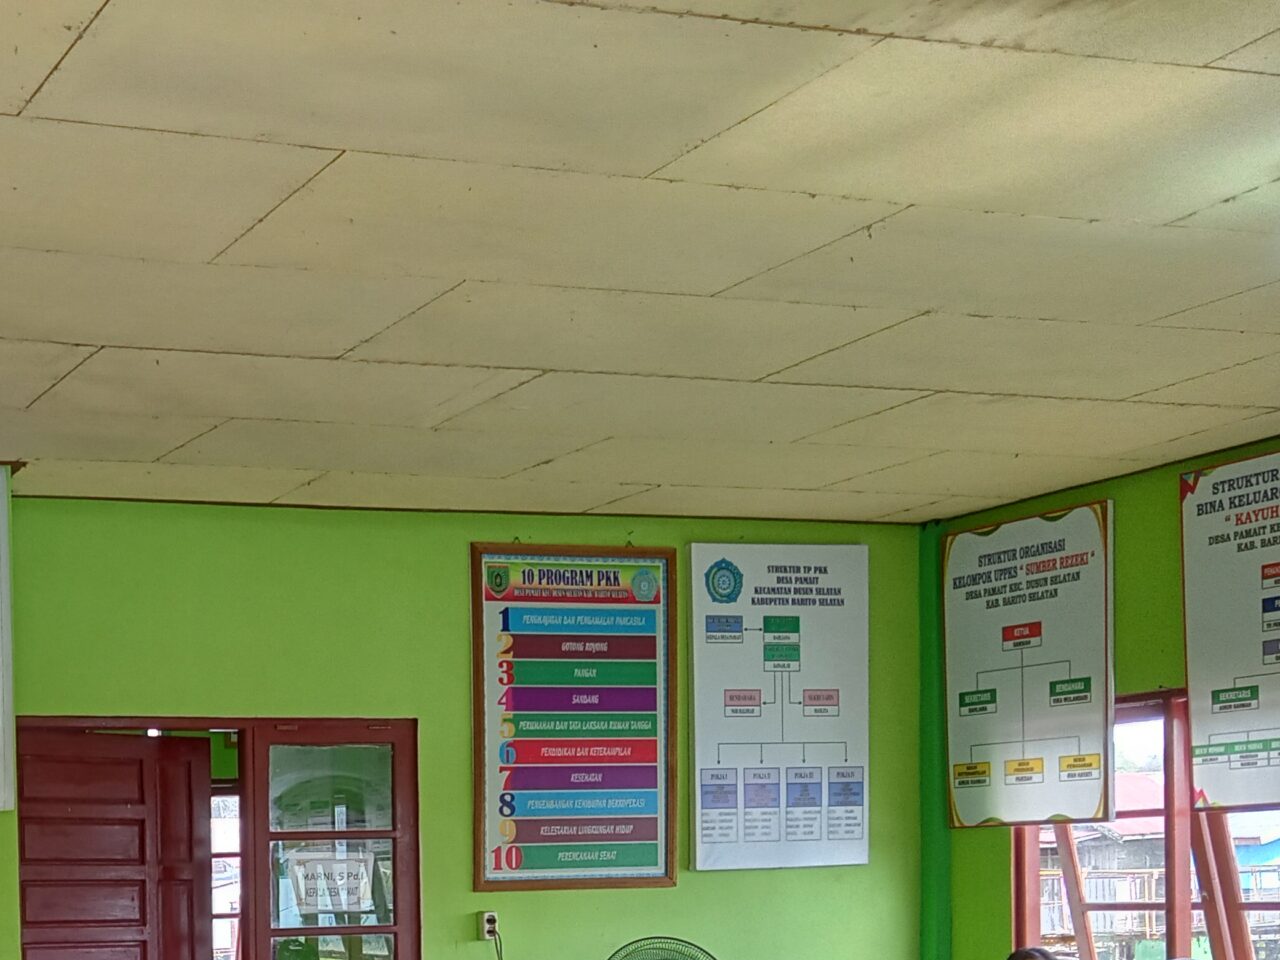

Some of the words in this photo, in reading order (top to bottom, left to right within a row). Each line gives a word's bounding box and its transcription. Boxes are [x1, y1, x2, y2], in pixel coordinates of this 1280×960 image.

[1212, 468, 1280, 495] STRUKTUR
[1196, 499, 1225, 516] BINA
[1228, 487, 1280, 510] KELUAR
[1235, 505, 1280, 526] KAYUH
[1208, 533, 1231, 546] DESA
[1233, 526, 1267, 541] PAMAIT
[1237, 540, 1258, 553] KAB.
[978, 549, 1018, 567] STRUKTUR
[1019, 538, 1066, 559] ORGANISASI
[521, 568, 534, 586] 10
[538, 569, 594, 586] PROGRAM
[597, 570, 621, 587] PKK
[767, 565, 801, 574] STRUKTUR
[803, 566, 811, 574] TP
[813, 566, 828, 574] PKK
[776, 576, 793, 584] DESA
[794, 576, 819, 585] PAMAIT
[953, 570, 993, 590] KELOMPOK
[994, 566, 1018, 583] UPPKS
[1025, 558, 1058, 576] SUMBER
[1059, 552, 1089, 569] REZEKI
[754, 586, 792, 595] KECAMATAN
[793, 587, 813, 595] DUSUN
[815, 587, 841, 595] SELATAN
[965, 588, 982, 601] DESA
[983, 585, 1007, 598] PAMAIT
[1050, 571, 1081, 586] SELATAN
[1028, 588, 1058, 602] SELATAN
[791, 598, 817, 606] BARITO
[818, 598, 845, 606] SELATAN
[498, 607, 511, 632] 1
[496, 634, 514, 659] 2
[498, 660, 515, 686] 3
[574, 668, 597, 677] PANGAN
[497, 686, 513, 712] 4
[499, 713, 516, 738] 5
[499, 740, 516, 765] 6
[498, 766, 515, 791] 7
[498, 793, 516, 817] 8
[499, 819, 517, 844] 9
[491, 845, 523, 870] 10
